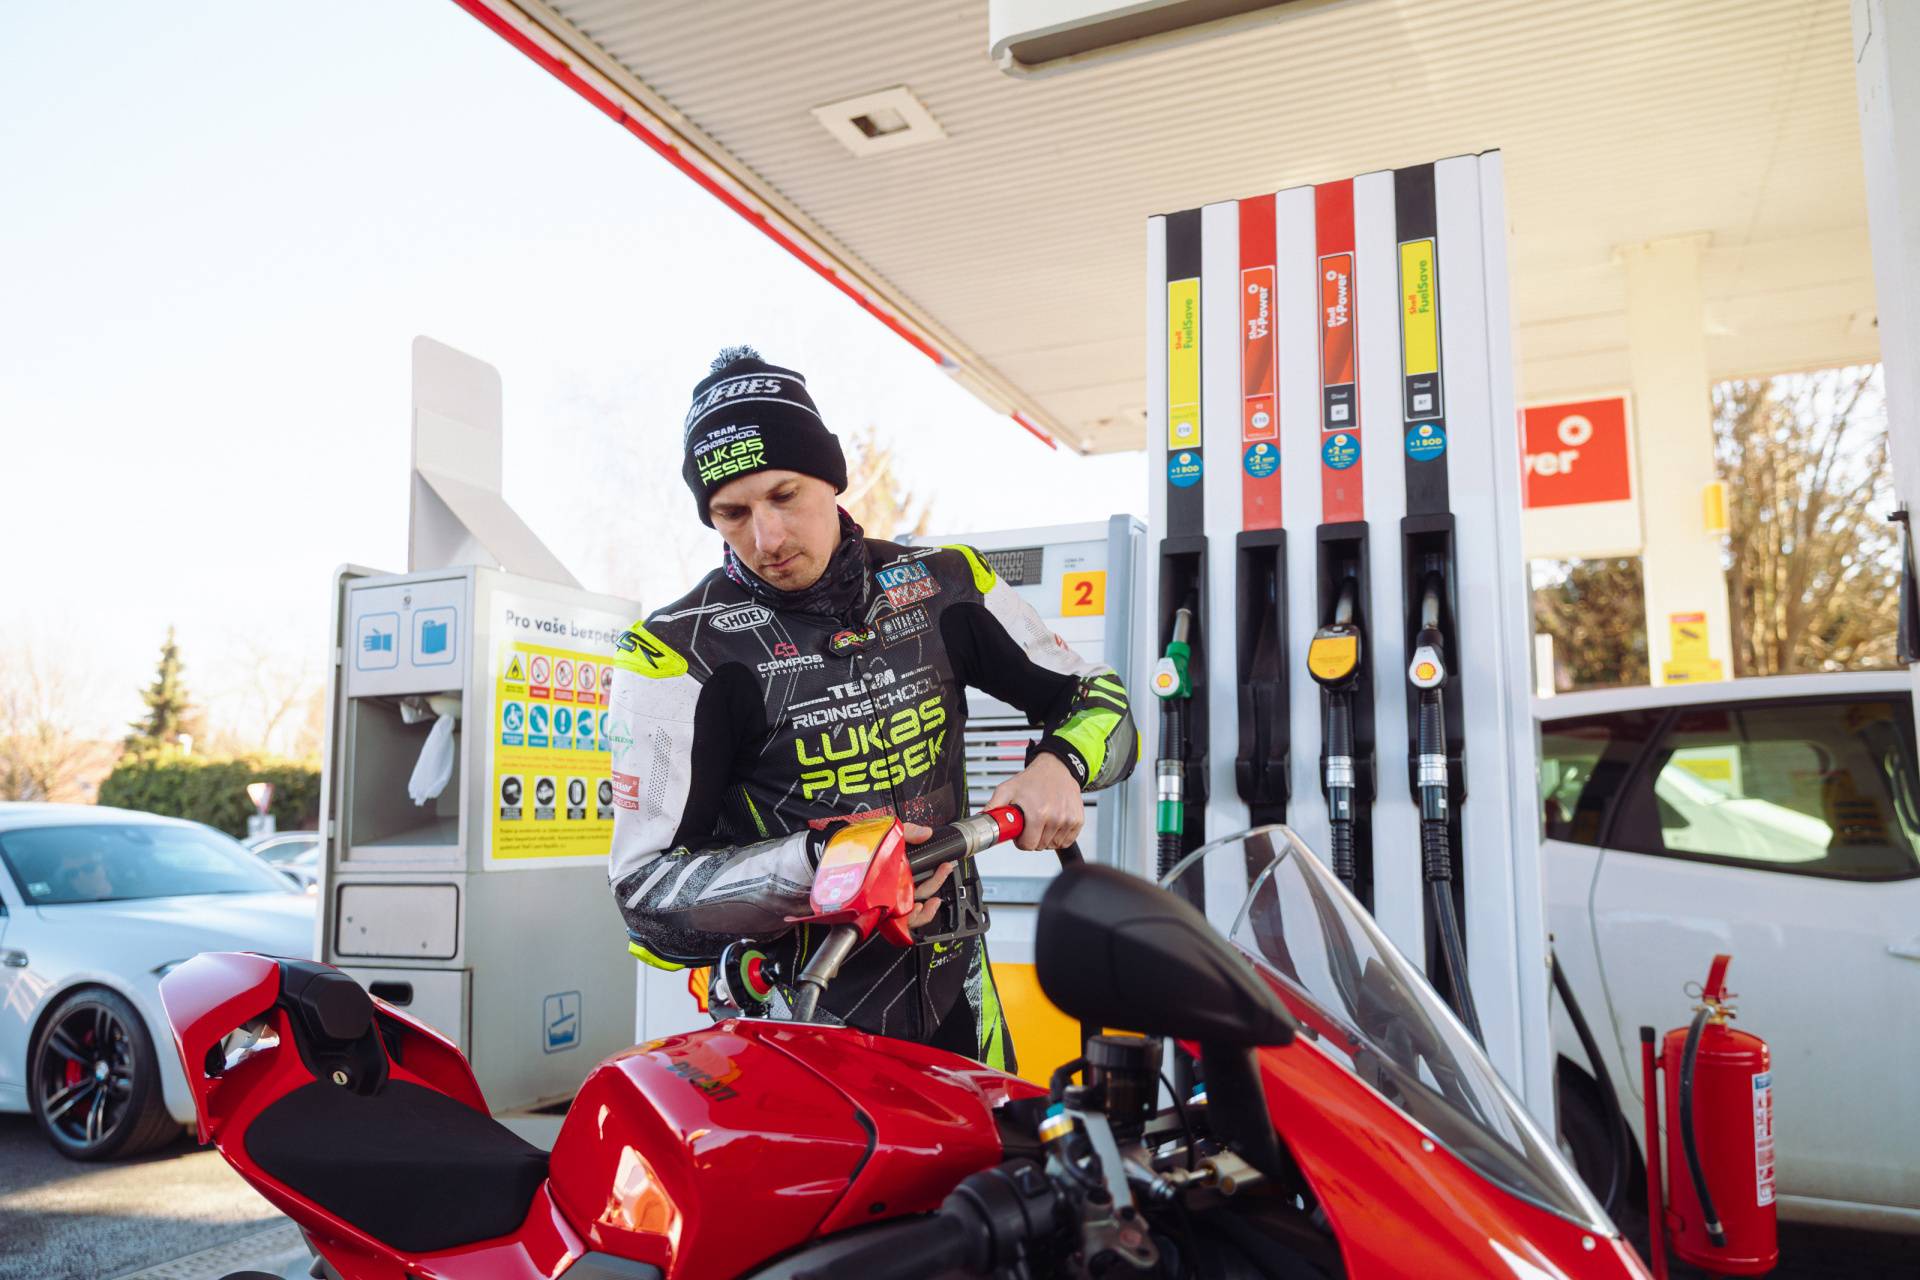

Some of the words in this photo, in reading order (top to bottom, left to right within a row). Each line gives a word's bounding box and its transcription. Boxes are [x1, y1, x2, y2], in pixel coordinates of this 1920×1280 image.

[1336, 272, 1348, 327] V-Power
[1417, 260, 1430, 314] FuelSave
[1183, 298, 1194, 350] FuelSave
[1257, 286, 1269, 339] V-Power
[1327, 306, 1337, 328] Shell
[1248, 319, 1257, 340] Shell
[706, 424, 737, 440] TEAM
[700, 451, 768, 487] PESEK
[879, 562, 927, 588] LIQUI
[1074, 580, 1094, 606] 2
[506, 609, 530, 630] Pro
[535, 618, 567, 636] vaše
[718, 608, 764, 629] SHOEI
[827, 668, 897, 701] TEAM
[791, 678, 940, 731] RIDINGSCHOOL
[800, 729, 948, 801] PESEK
